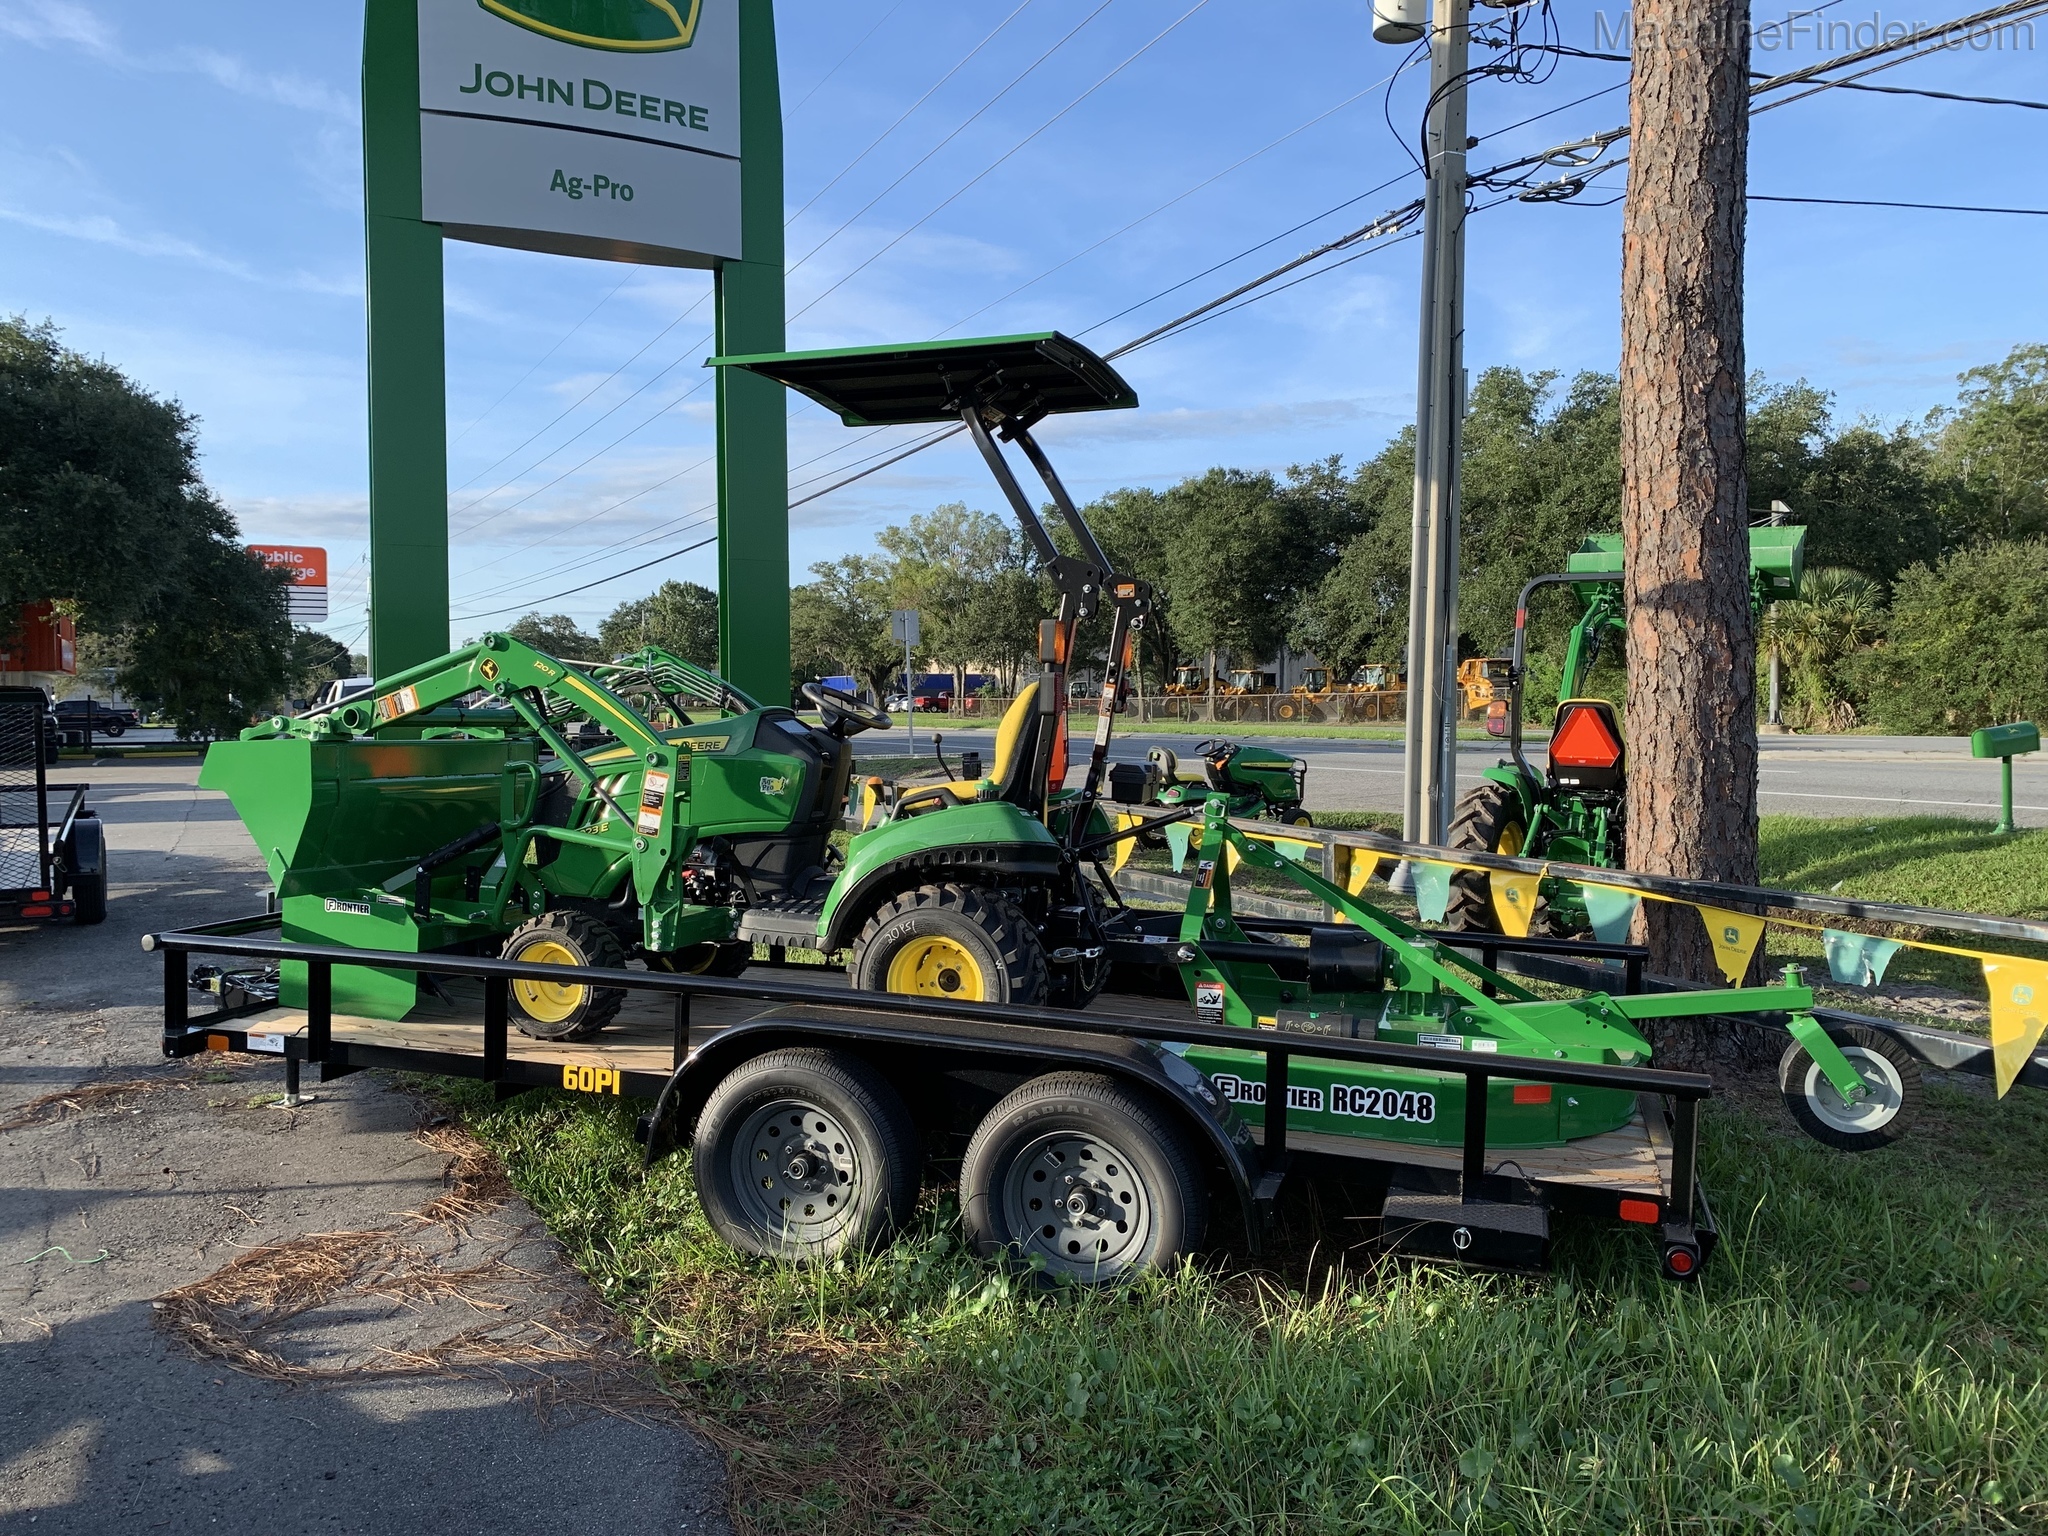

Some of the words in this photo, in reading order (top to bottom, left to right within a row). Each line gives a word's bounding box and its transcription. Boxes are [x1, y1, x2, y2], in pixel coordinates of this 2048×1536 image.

[460, 63, 574, 107] JOHN
[583, 78, 709, 132] DEERE
[549, 169, 634, 202] Ag-Pro
[325, 898, 370, 914] FRONTIER
[563, 1064, 620, 1095] 60PI
[1213, 1075, 1321, 1110] FROTIER
[1332, 1086, 1433, 1121] RC2048
[1012, 1104, 1093, 1127] RADIAL
